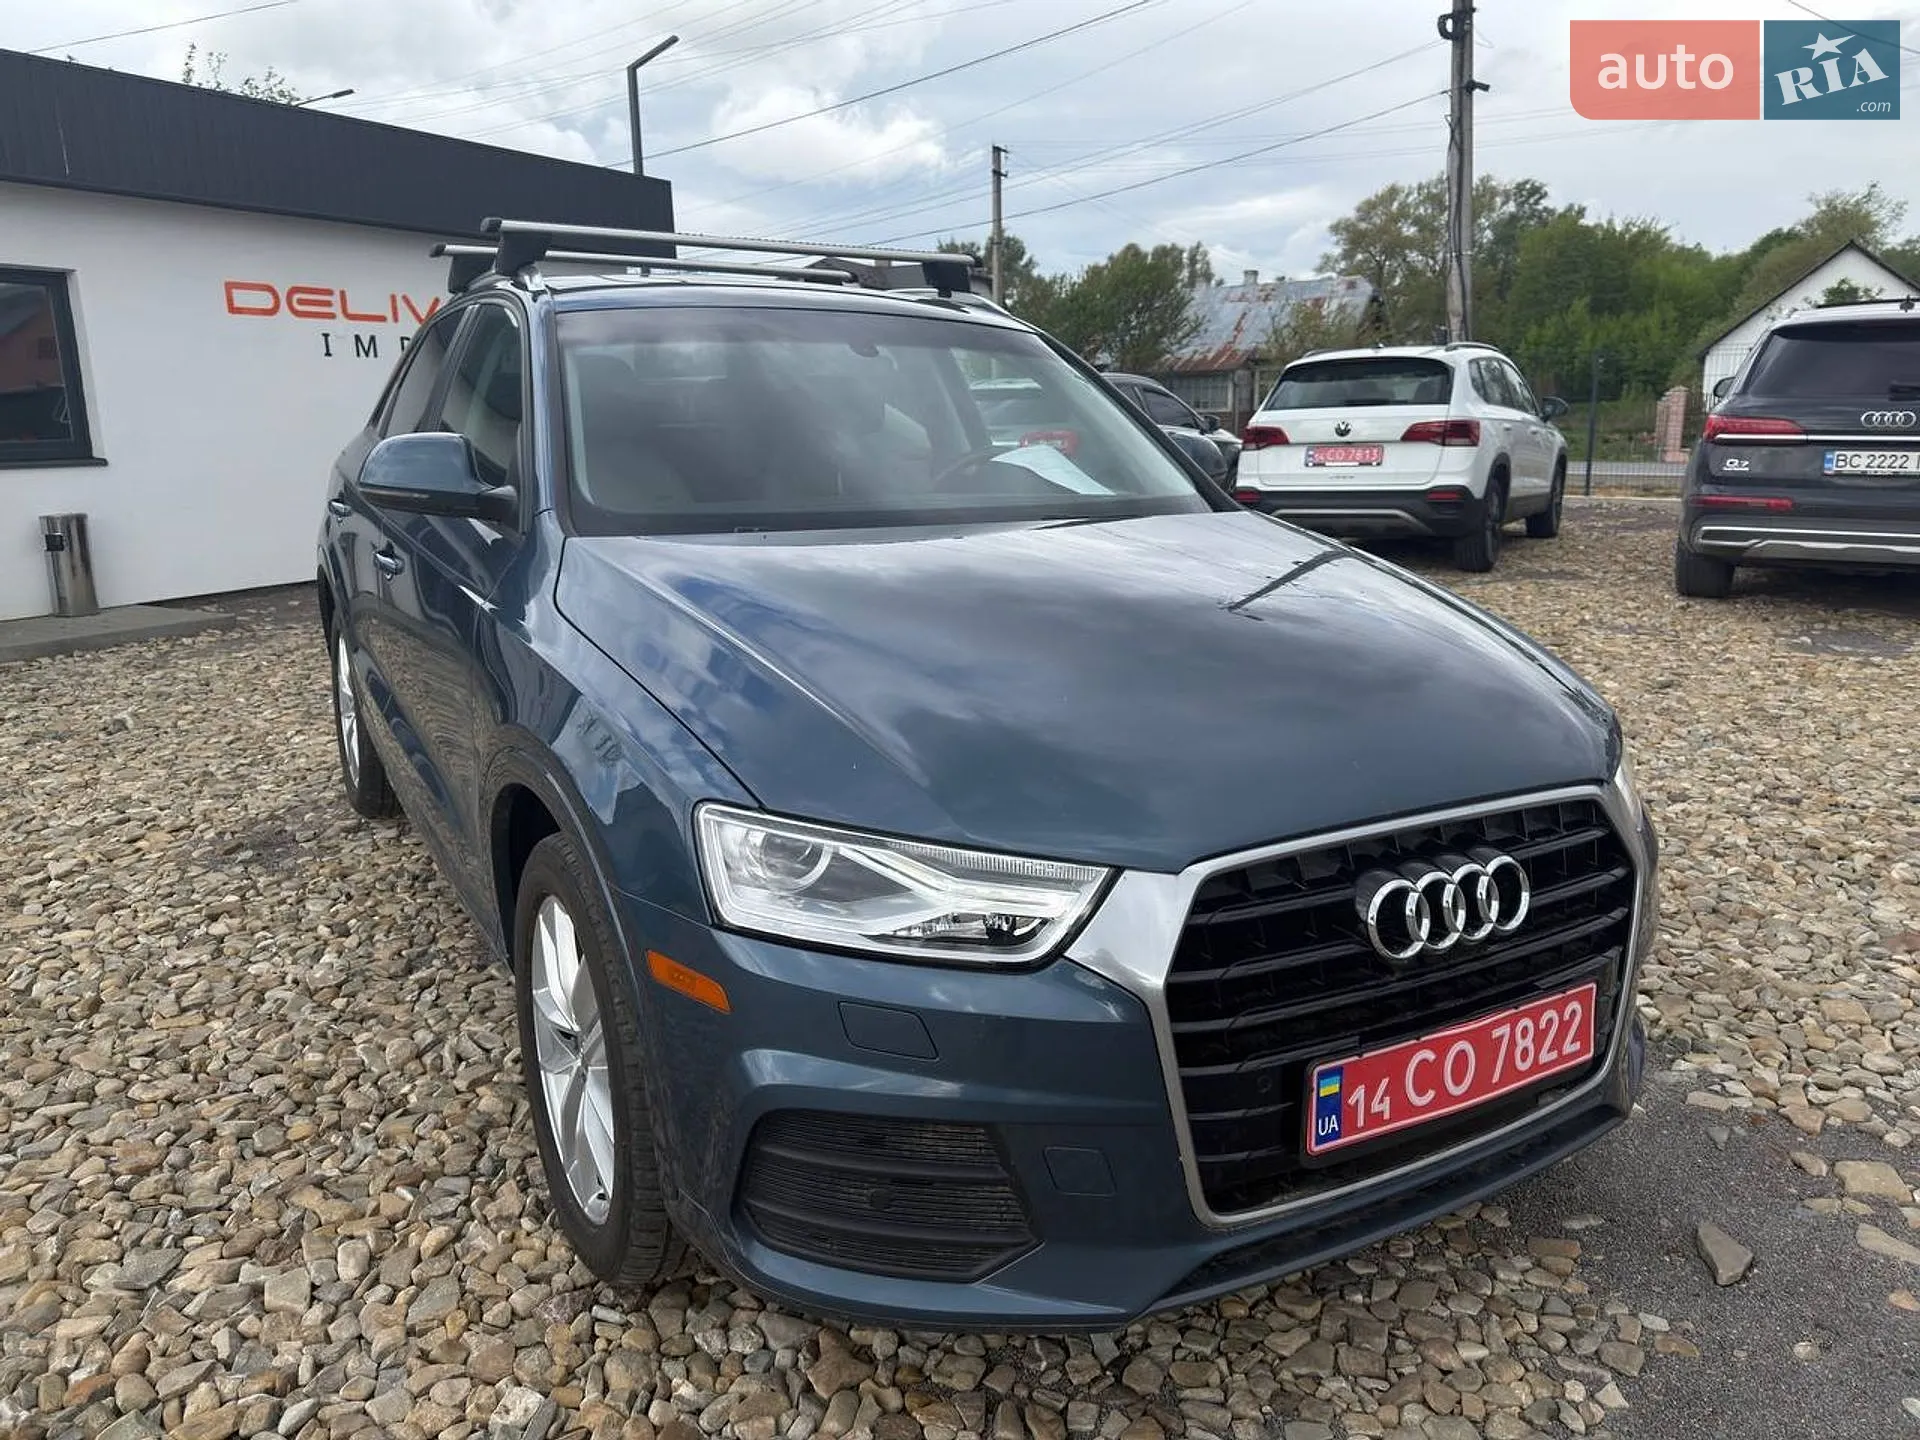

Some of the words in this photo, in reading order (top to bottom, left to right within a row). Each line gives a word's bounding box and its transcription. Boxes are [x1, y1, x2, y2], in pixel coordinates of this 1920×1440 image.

[224, 280, 441, 325] DELIV
[1835, 452, 1862, 469] BC
[1865, 453, 1910, 469] 2222
[1347, 1076, 1392, 1129] 14
[1405, 1039, 1476, 1107] CO
[1491, 1000, 1583, 1084] 7822
[1318, 1114, 1339, 1137] UA
